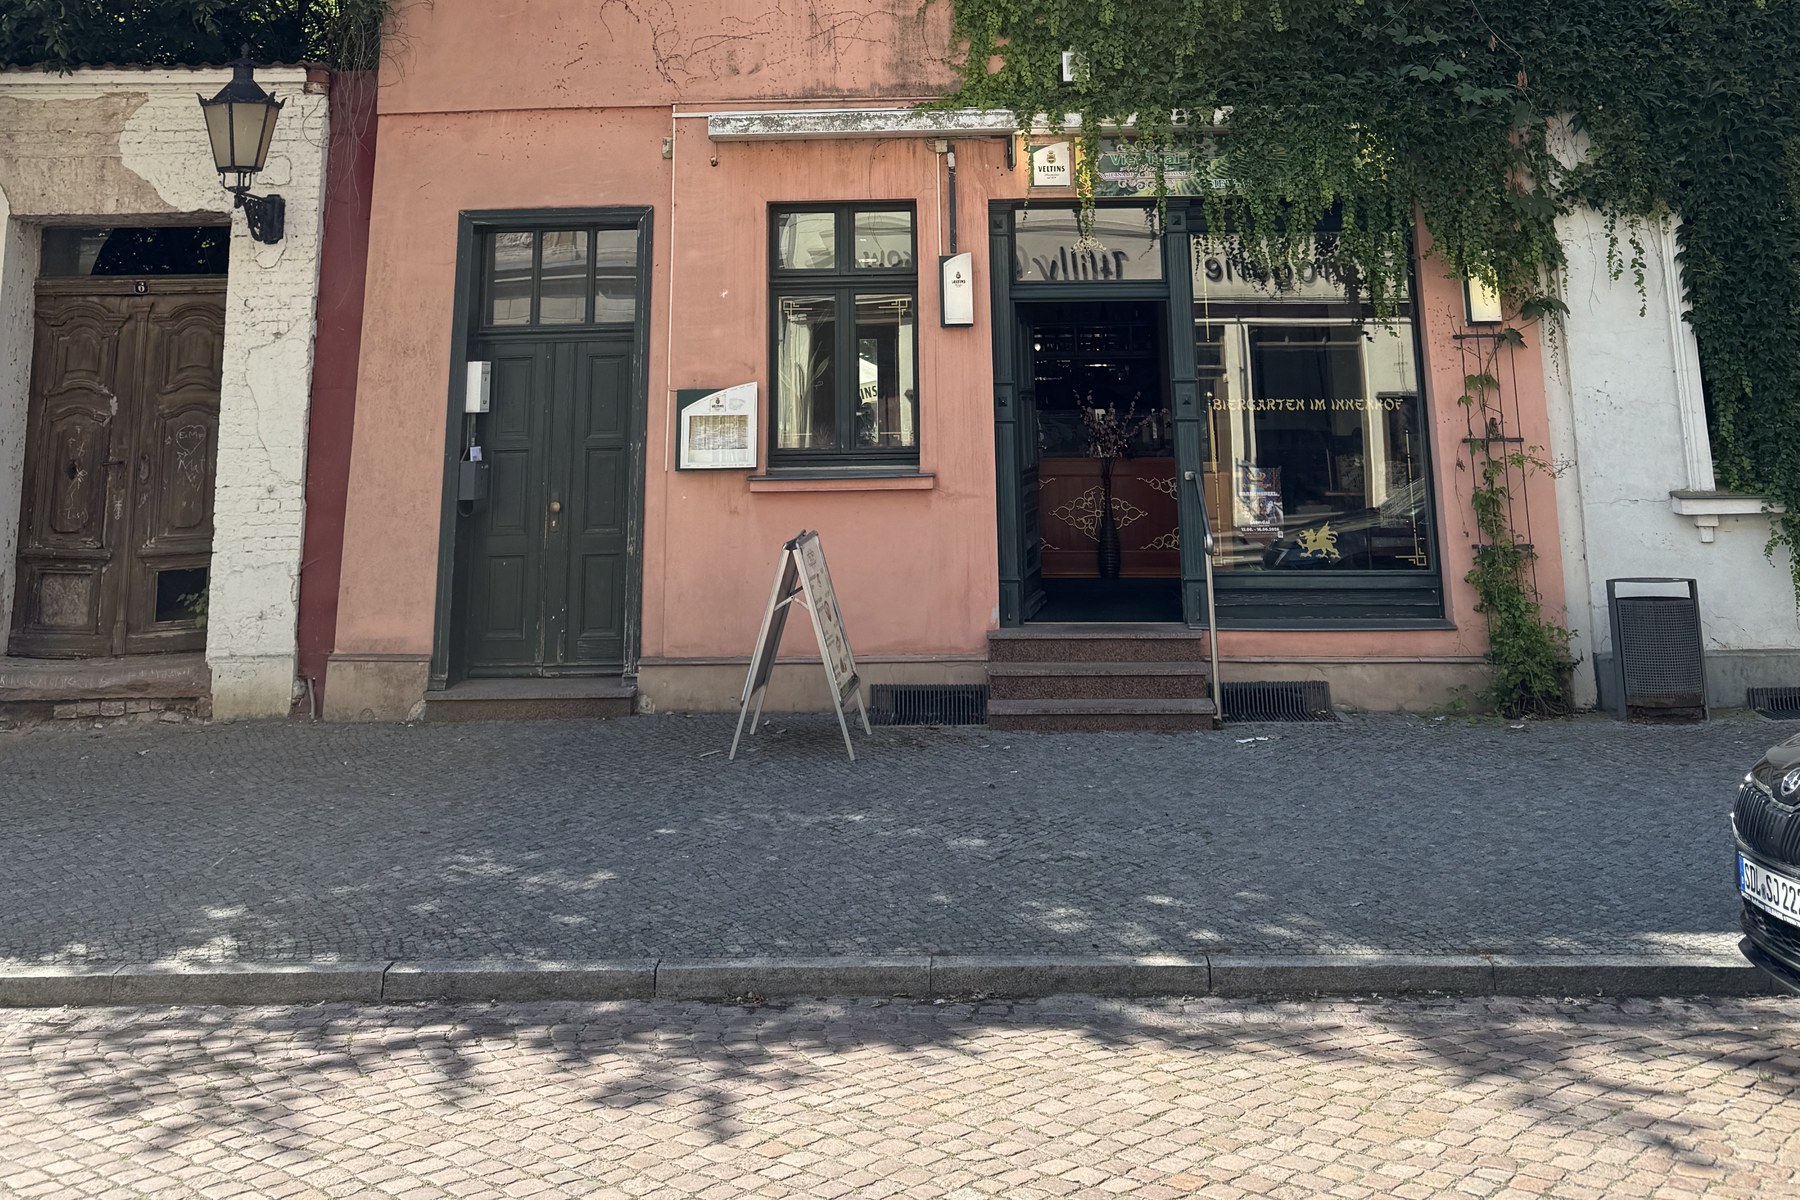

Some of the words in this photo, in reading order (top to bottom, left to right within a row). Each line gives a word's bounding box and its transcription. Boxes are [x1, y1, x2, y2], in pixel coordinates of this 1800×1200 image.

[1145, 152, 1180, 166] Tai
[1213, 399, 1305, 411] BIERGARTEN
[1310, 398, 1327, 411] IM
[1332, 398, 1403, 411] INNENHOF
[1745, 863, 1761, 897] SDL
[1766, 874, 1779, 906] SJ
[1782, 882, 1800, 916] 22
